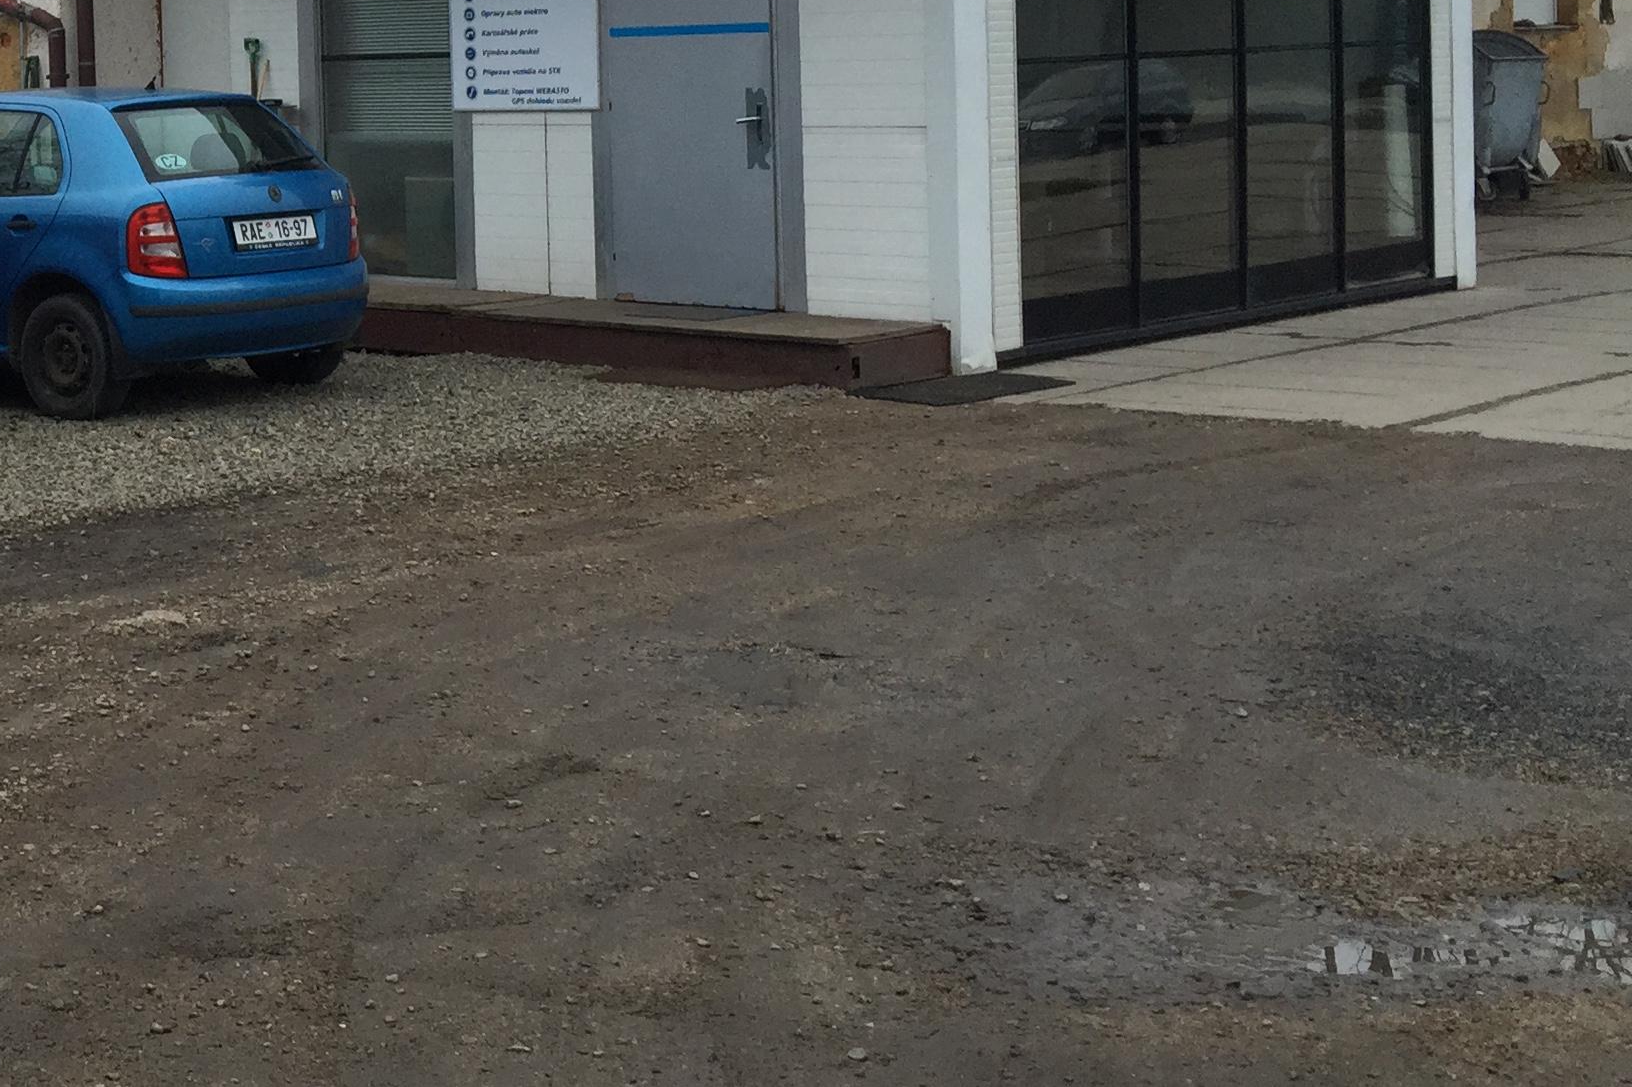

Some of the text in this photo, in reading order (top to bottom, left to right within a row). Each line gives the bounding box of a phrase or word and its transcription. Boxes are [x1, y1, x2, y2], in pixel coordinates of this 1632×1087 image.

[160, 156, 183, 168] CZ
[240, 218, 308, 242] RAE 16-97
